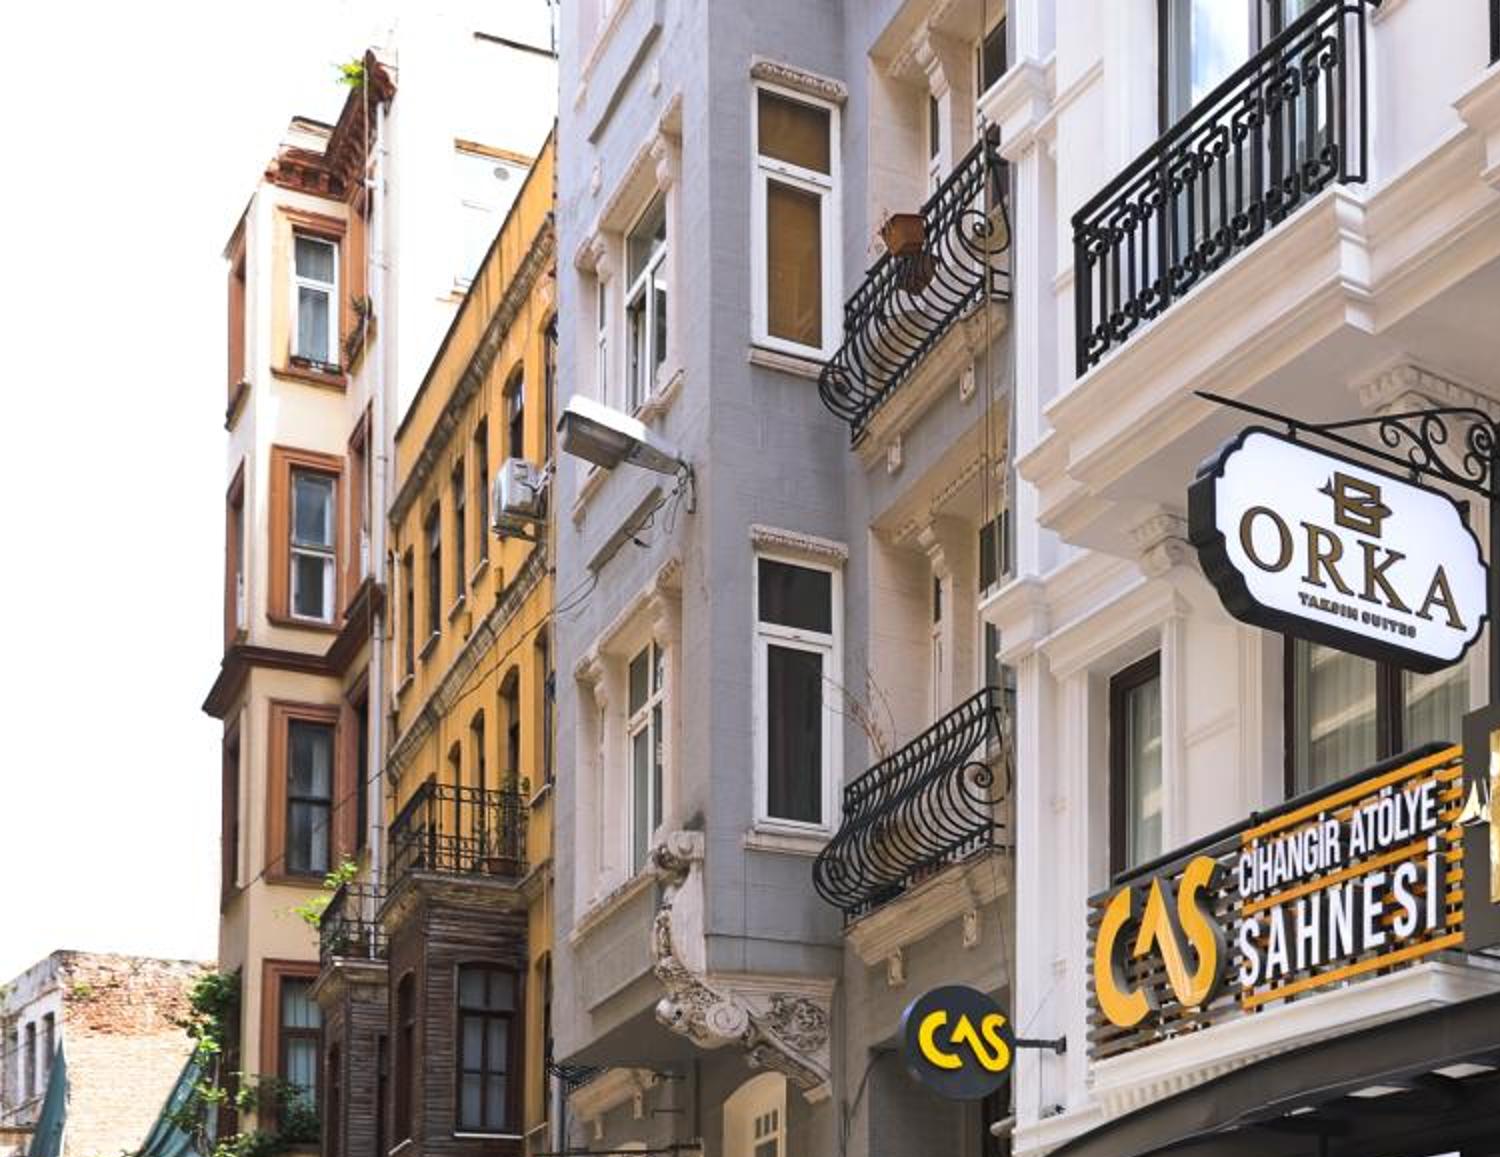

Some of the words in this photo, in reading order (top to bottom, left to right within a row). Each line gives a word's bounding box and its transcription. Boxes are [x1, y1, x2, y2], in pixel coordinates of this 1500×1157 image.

[1239, 505, 1467, 632] ORKA
[1298, 591, 1358, 621] TAKSIM
[1361, 611, 1417, 639] SUITES
[1238, 812, 1341, 898] CİHANGİR
[1349, 778, 1437, 858] ATÖLYE
[1094, 855, 1218, 1028] CAS
[1238, 835, 1437, 988] SAHNESİ
[918, 1009, 1011, 1072] CAS
